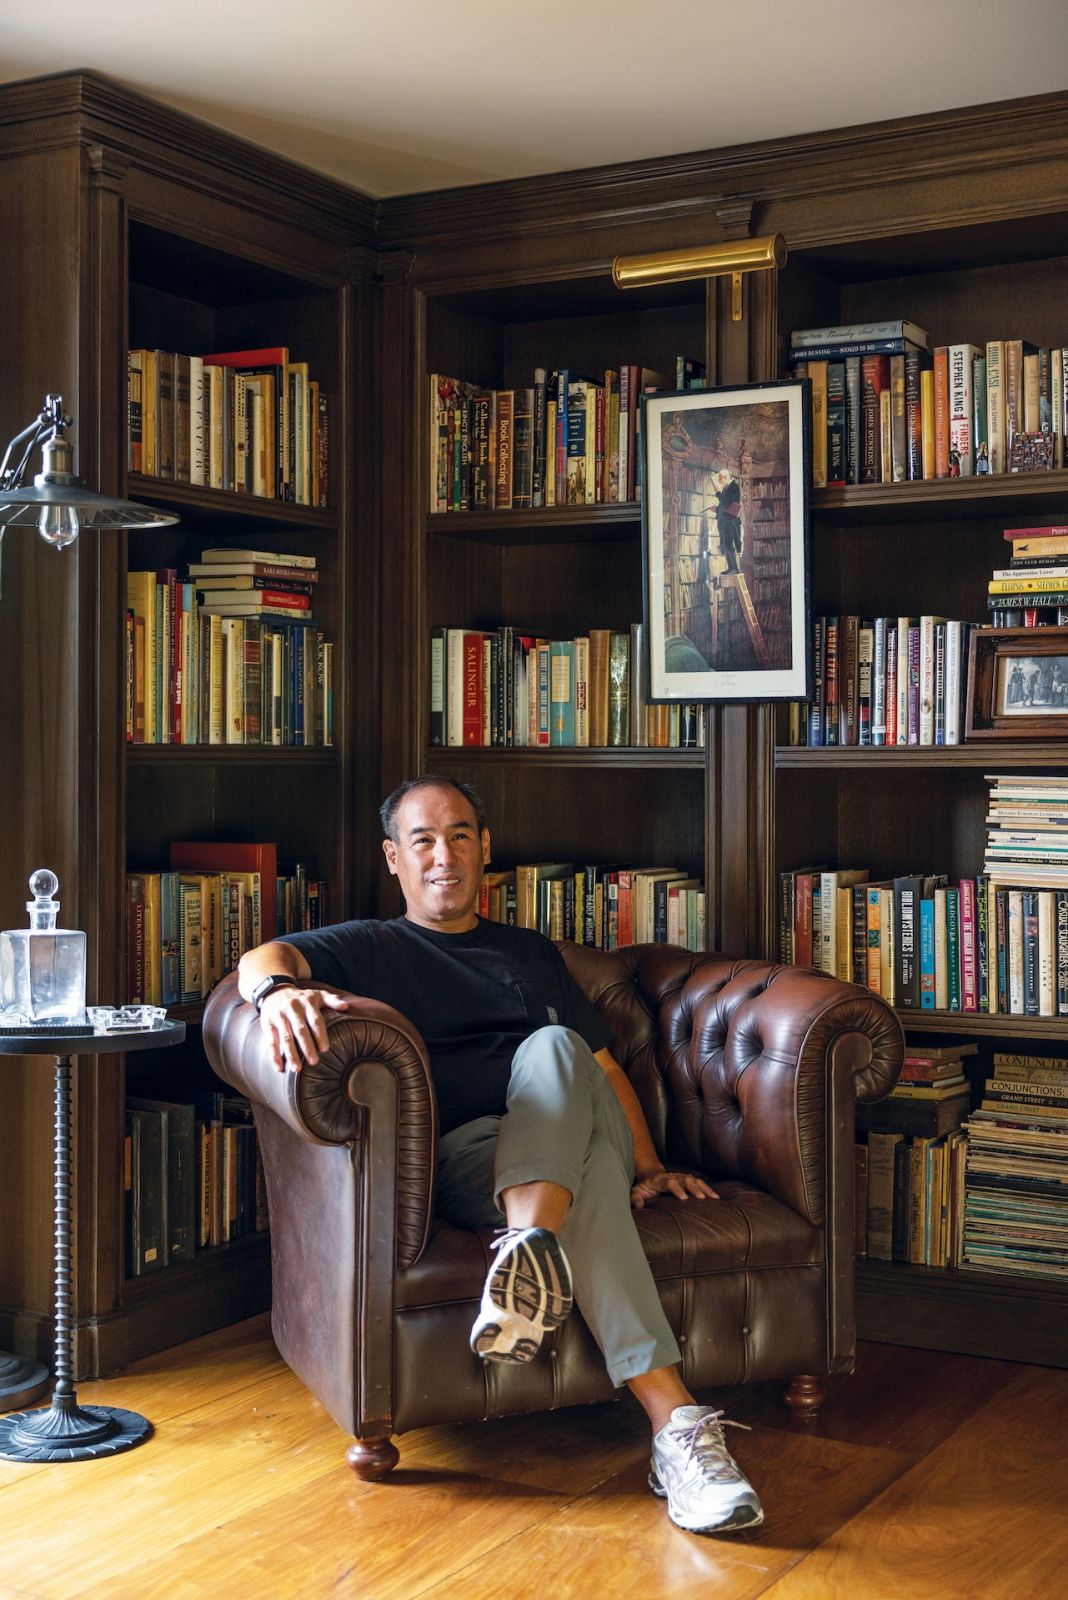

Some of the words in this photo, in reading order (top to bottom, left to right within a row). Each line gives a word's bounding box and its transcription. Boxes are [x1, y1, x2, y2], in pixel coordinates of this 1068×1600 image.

[953, 352, 964, 389] STEPHEN
[953, 391, 964, 412] KING
[480, 401, 488, 439] Collected
[909, 405, 917, 425] JOHN
[498, 420, 508, 442] Book
[960, 424, 969, 456] FINDERS
[480, 442, 488, 465] Books
[909, 428, 917, 464] DUNNING
[498, 443, 508, 485] Collecting
[997, 598, 1023, 608] JAMES
[1032, 597, 1053, 606] HALL
[467, 646, 477, 707] SALINGER
[875, 674, 884, 704] Typhoon
[577, 683, 586, 709] STORY
[813, 706, 821, 732] MATTER
[586, 894, 594, 916] DEADLY
[823, 878, 831, 910] MATTHEW
[823, 912, 831, 934] PEARL
[902, 890, 914, 952] BIBLIOMYSTERIES
[963, 922, 972, 931] THE
[1058, 901, 1068, 927] CASUAL
[586, 917, 594, 942] MUSINGS
[1058, 929, 1068, 968] SLAUGHTERS
[991, 1081, 1065, 1097] CONJUNCTIONS:
[1001, 1094, 1023, 1102] GRAND
[1024, 1096, 1045, 1105] STREET
